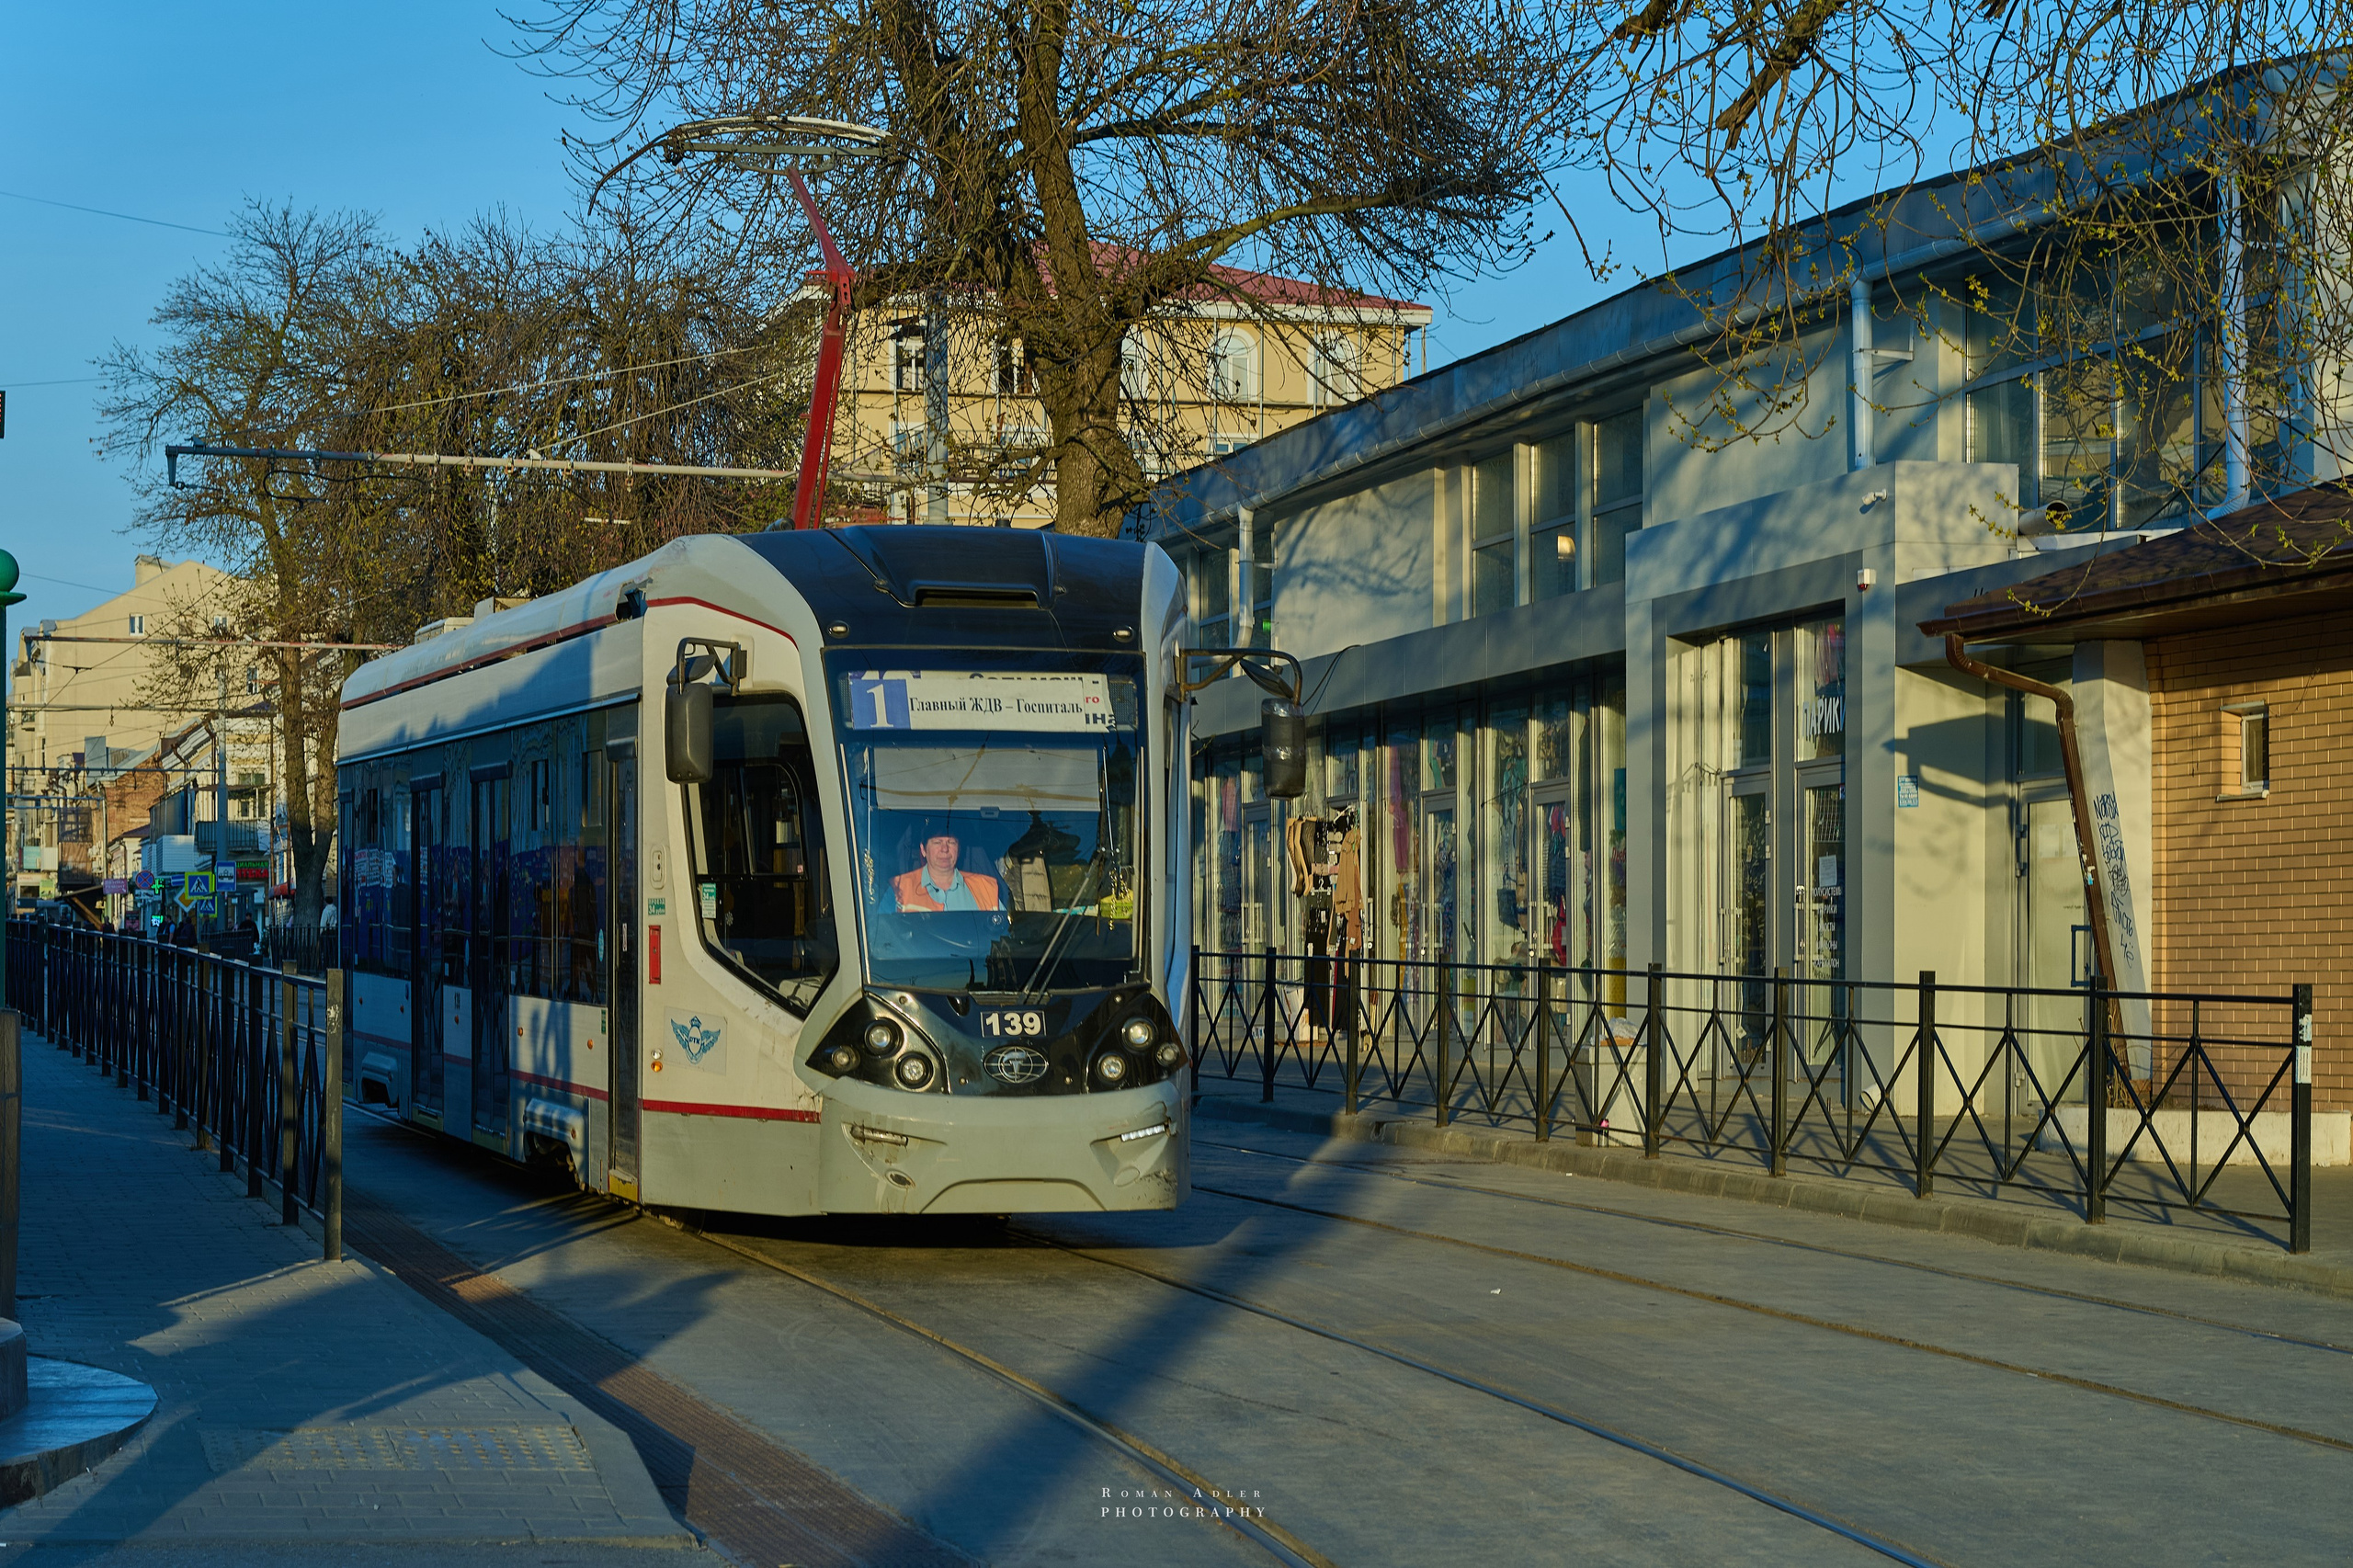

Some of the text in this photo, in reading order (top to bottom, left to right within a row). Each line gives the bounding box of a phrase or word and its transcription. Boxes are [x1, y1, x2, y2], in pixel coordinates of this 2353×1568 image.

[866, 684, 893, 728] 1
[910, 698, 967, 712] Главный
[970, 698, 1003, 715] ЖДВ
[1017, 698, 1083, 714] Госпиталь
[648, 904, 655, 915] 34
[985, 1011, 1041, 1036] 139
